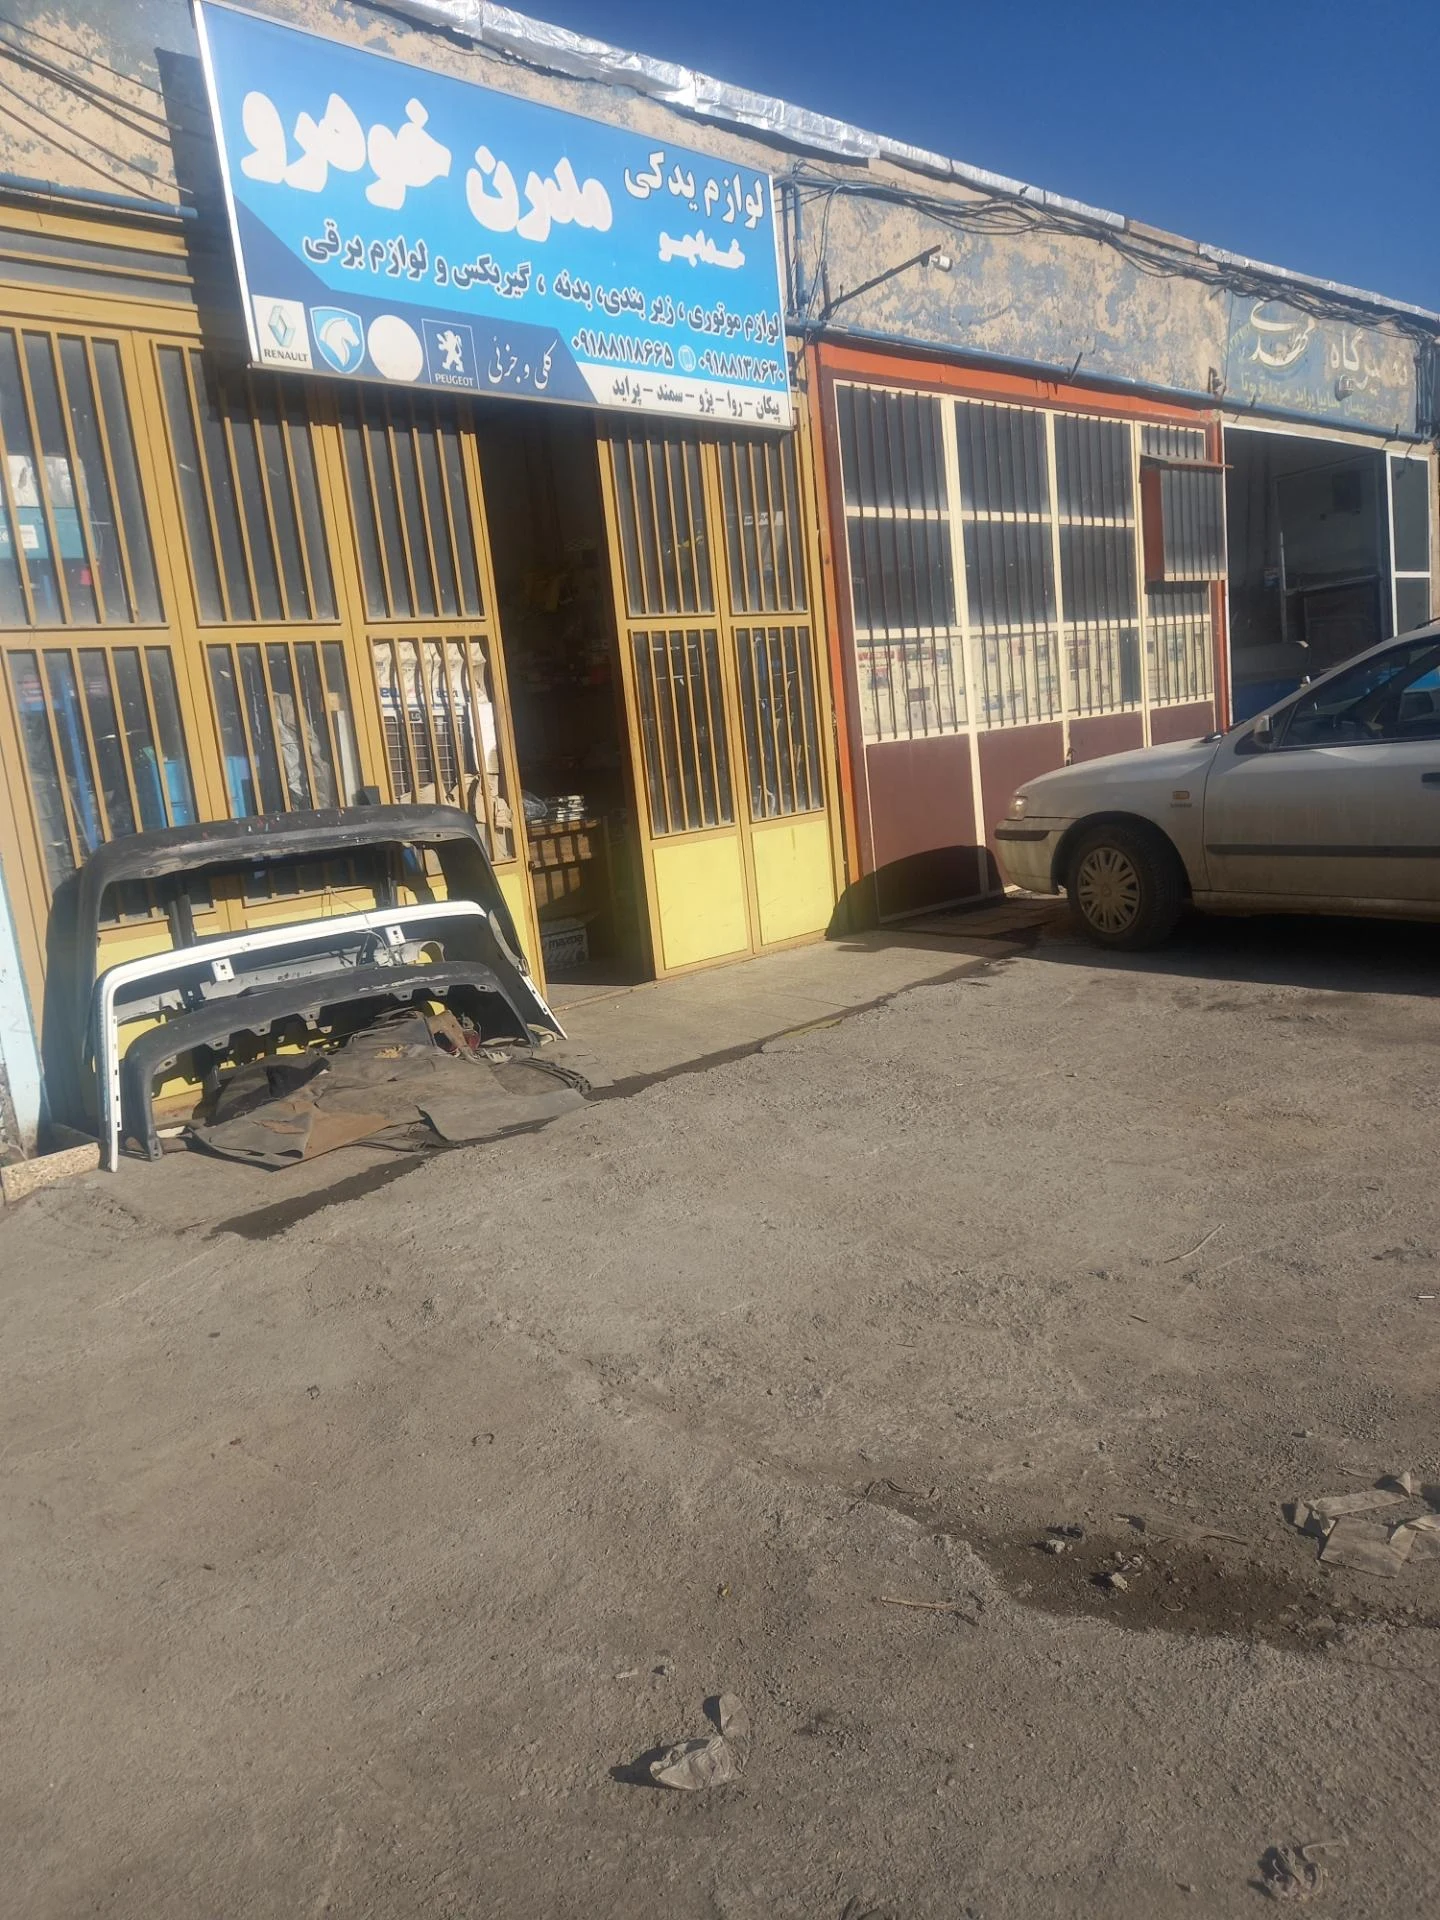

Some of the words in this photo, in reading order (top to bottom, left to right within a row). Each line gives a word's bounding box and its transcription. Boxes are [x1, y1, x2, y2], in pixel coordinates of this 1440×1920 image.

[241, 91, 451, 210] خودرو
[466, 145, 612, 242] مدرن
[624, 152, 699, 211] یدکی
[704, 173, 764, 229] لوازم
[303, 219, 364, 268] برقی
[369, 235, 428, 279] لوازم
[436, 257, 448, 285] و
[452, 255, 530, 297] گیربکس
[554, 269, 592, 309] بدنه
[650, 296, 675, 326] زیر
[687, 302, 742, 338] موتوری
[744, 311, 781, 344] لوازم
[263, 348, 309, 363] RENAULT
[524, 364, 530, 379] و
[535, 339, 557, 389] کلی
[434, 372, 474, 387] PEUGEOT
[612, 375, 641, 405] پراید
[657, 383, 683, 402] سمند
[699, 388, 715, 414] پژو
[727, 389, 743, 417] روا
[756, 394, 781, 422] پیکان
